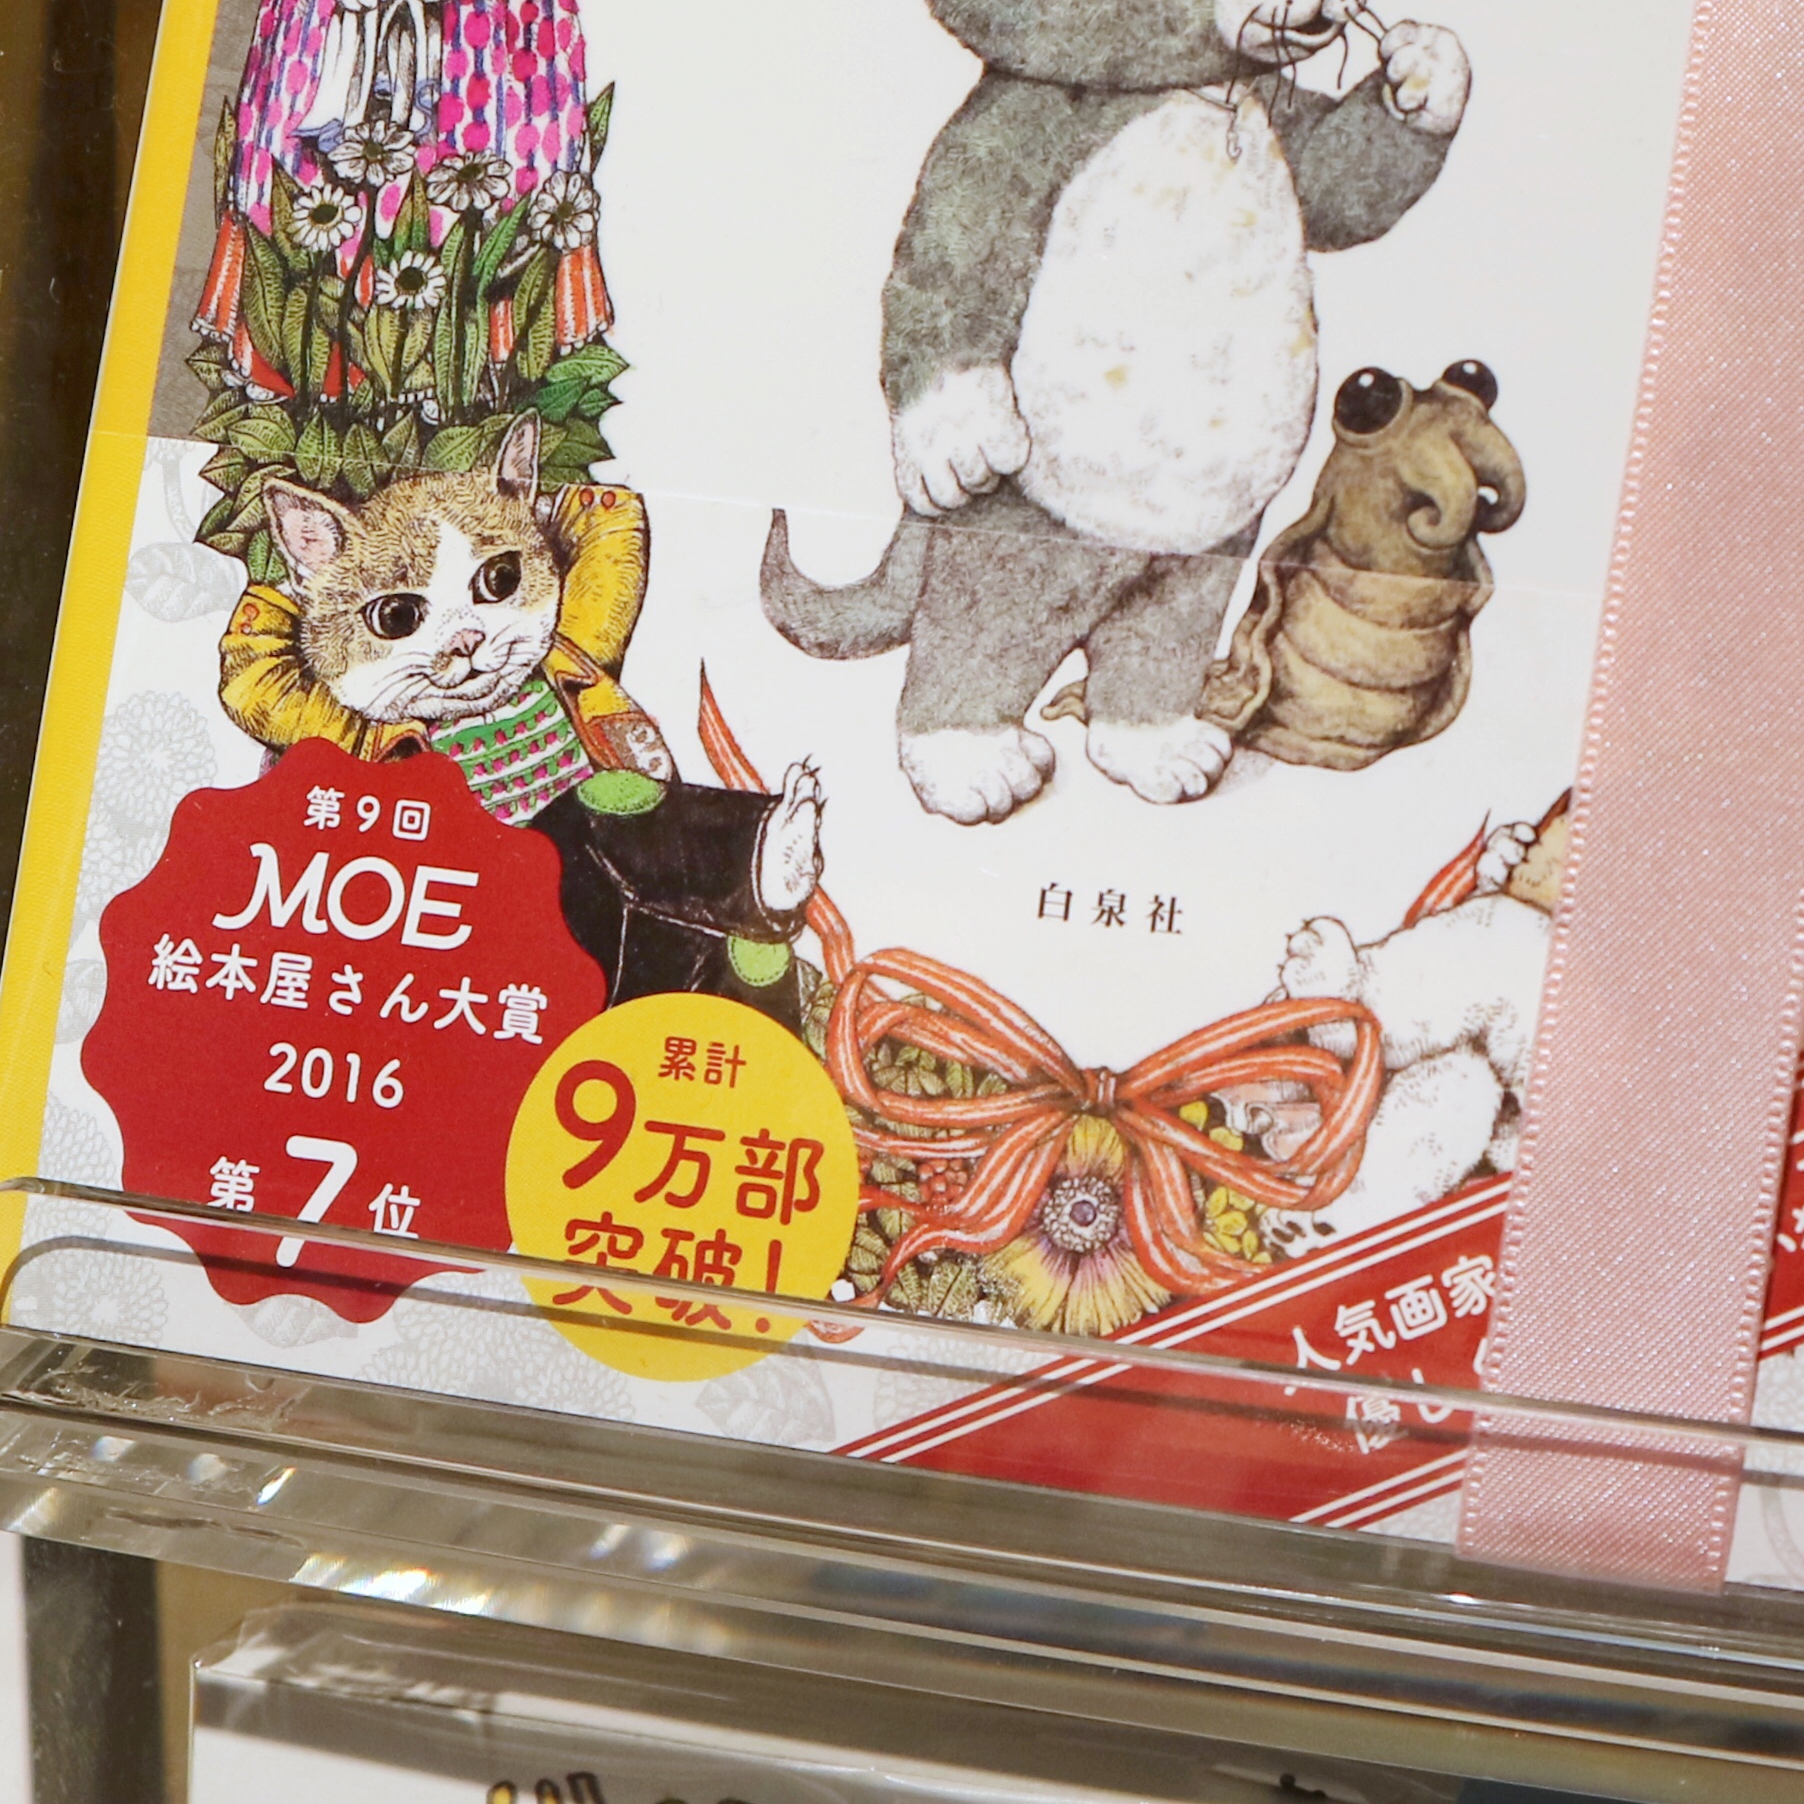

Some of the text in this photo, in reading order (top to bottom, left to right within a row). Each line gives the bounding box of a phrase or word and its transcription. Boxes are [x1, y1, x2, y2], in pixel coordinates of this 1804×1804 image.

[304, 785, 431, 842] 第9回
[212, 842, 482, 951] MOE
[1038, 882, 1183, 934] 白泉社
[148, 934, 549, 1046] 絵本屋さん大賞
[263, 1042, 405, 1110] 2016
[658, 1036, 747, 1088] 累計
[553, 1060, 826, 1225] 9万部
[208, 1135, 422, 1267] 第7位
[1284, 1255, 1497, 1396] 人気画家
